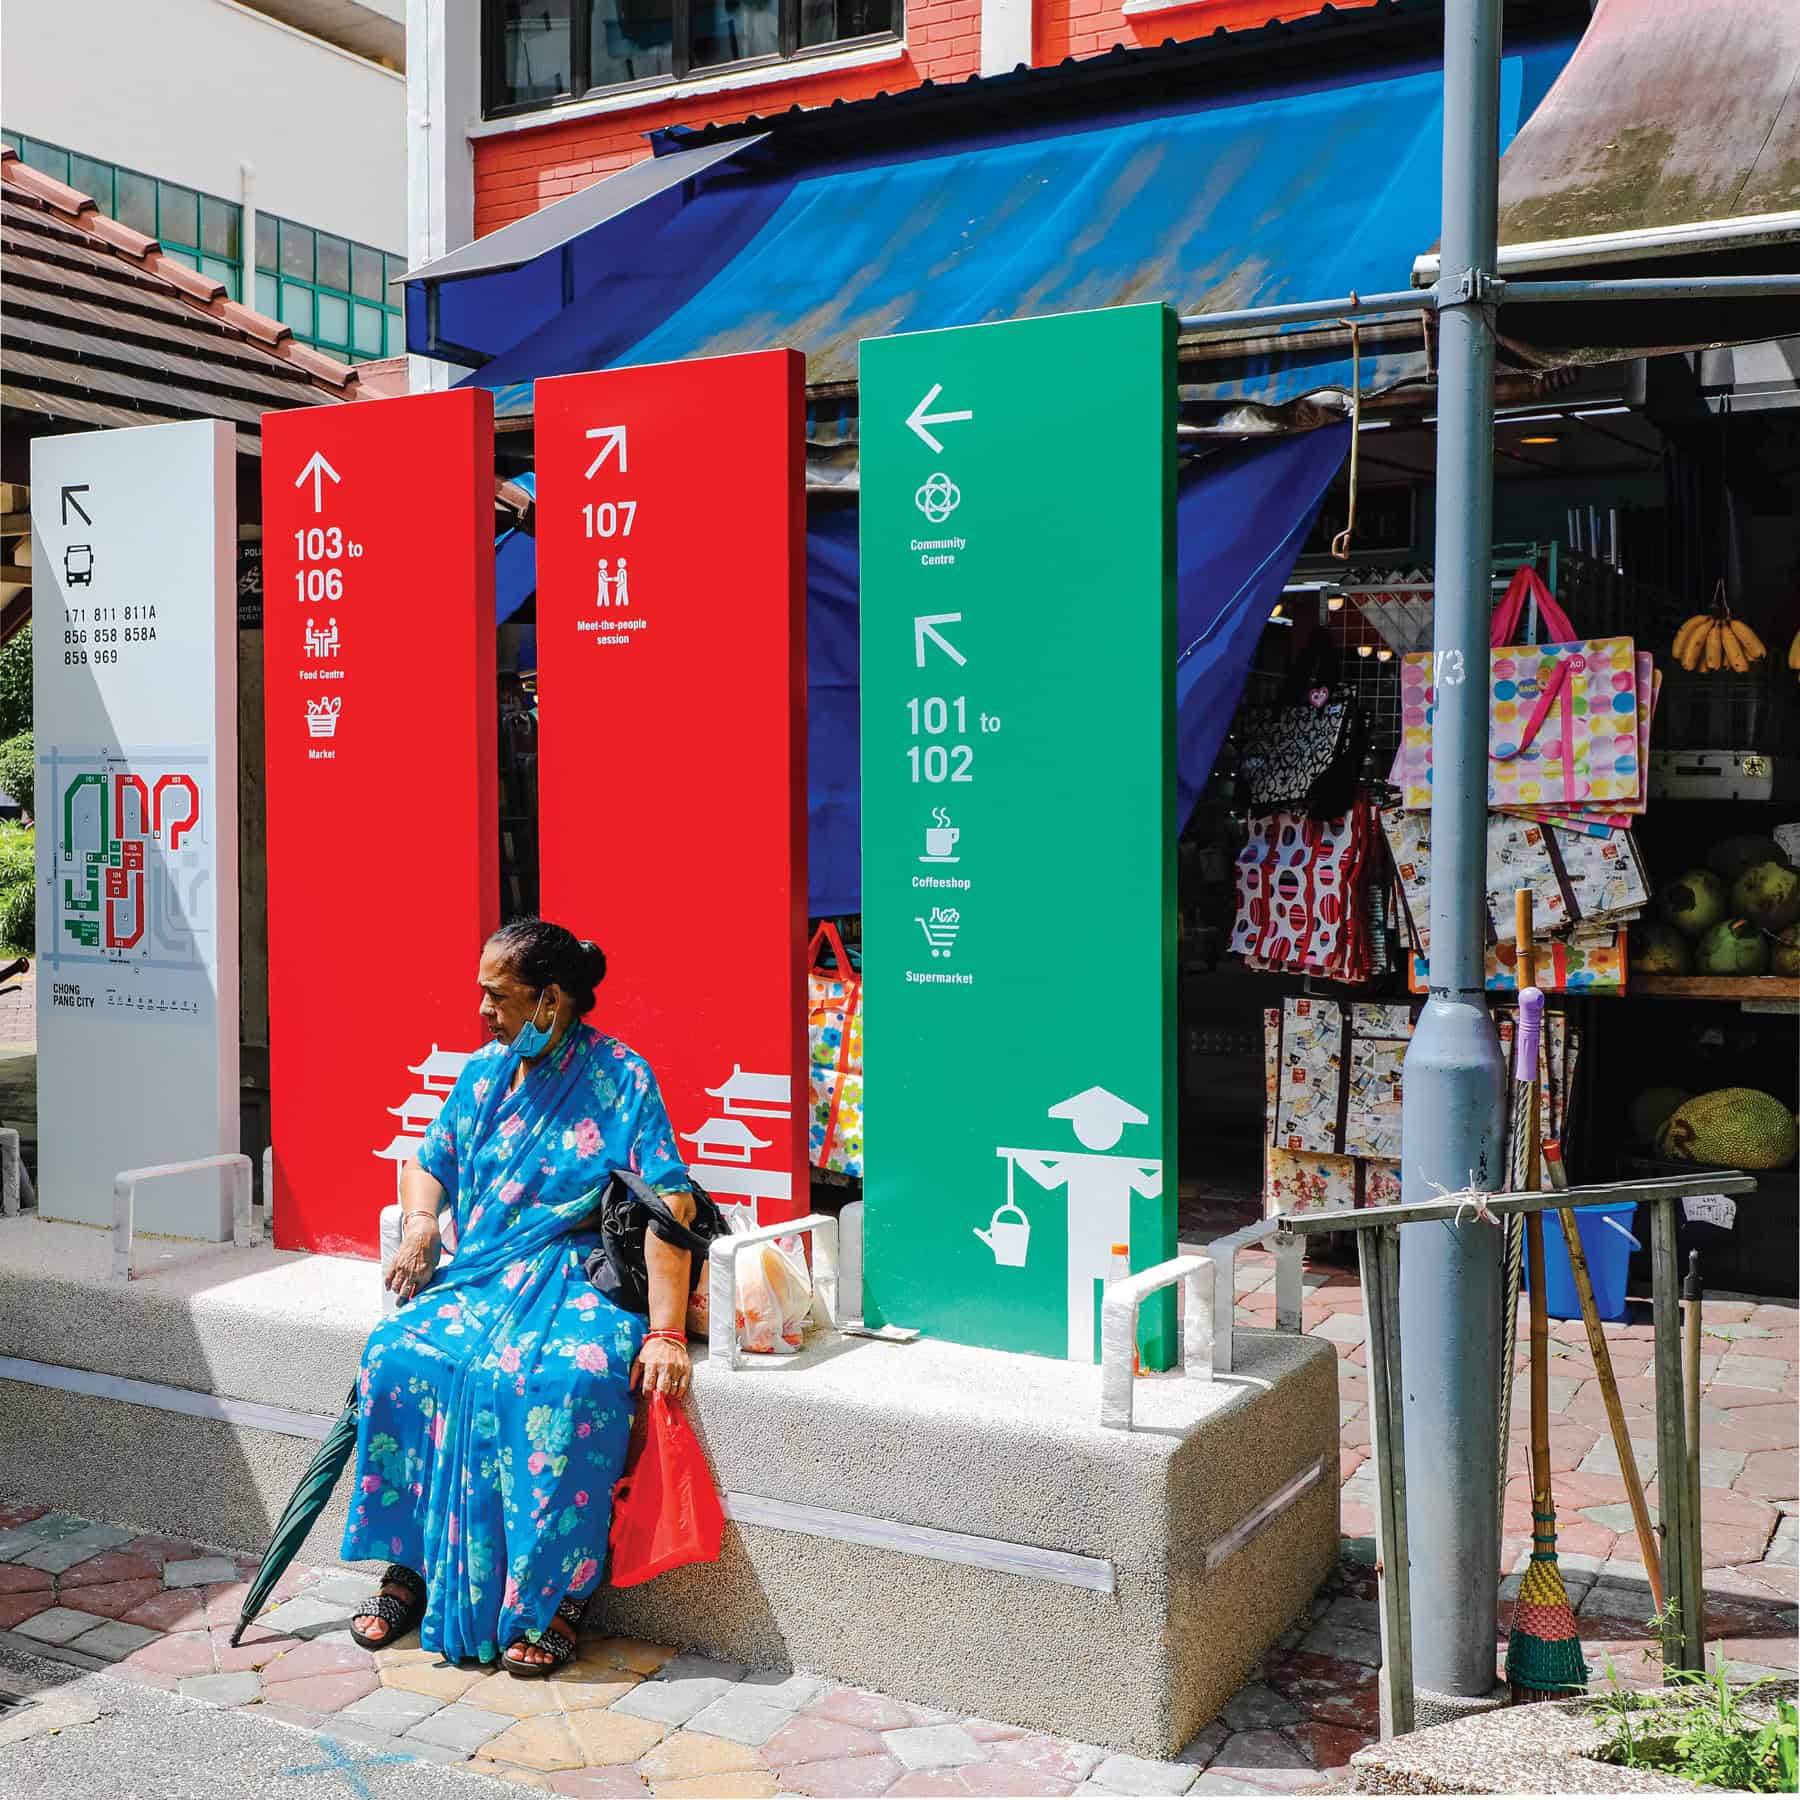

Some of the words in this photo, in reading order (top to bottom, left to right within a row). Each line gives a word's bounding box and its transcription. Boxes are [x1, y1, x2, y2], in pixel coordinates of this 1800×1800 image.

[581, 500, 638, 539] 107
[294, 526, 344, 562] 103
[347, 540, 364, 559] to
[910, 536, 967, 552] Community
[921, 553, 955, 566] Centre
[295, 568, 344, 603] 106
[65, 608, 86, 623] 171
[94, 607, 116, 622] 811
[124, 604, 157, 621] 811A
[576, 617, 648, 633] Meet-the-people
[64, 629, 87, 645] 856
[94, 628, 118, 643] 858
[124, 626, 157, 642] 858A
[596, 633, 630, 645] session
[64, 650, 88, 665] 859
[94, 649, 118, 664] 969
[299, 670, 318, 680] Food
[319, 669, 345, 680] Centre
[906, 695, 967, 736] 101
[979, 711, 1001, 733] to
[308, 748, 337, 760] Market
[906, 743, 974, 784] 102
[911, 875, 971, 891] Coffeeshop
[905, 970, 974, 986] Supermarket
[53, 983, 80, 996] CHONG
[53, 994, 75, 1007] PANG
[76, 996, 95, 1009] CITY
